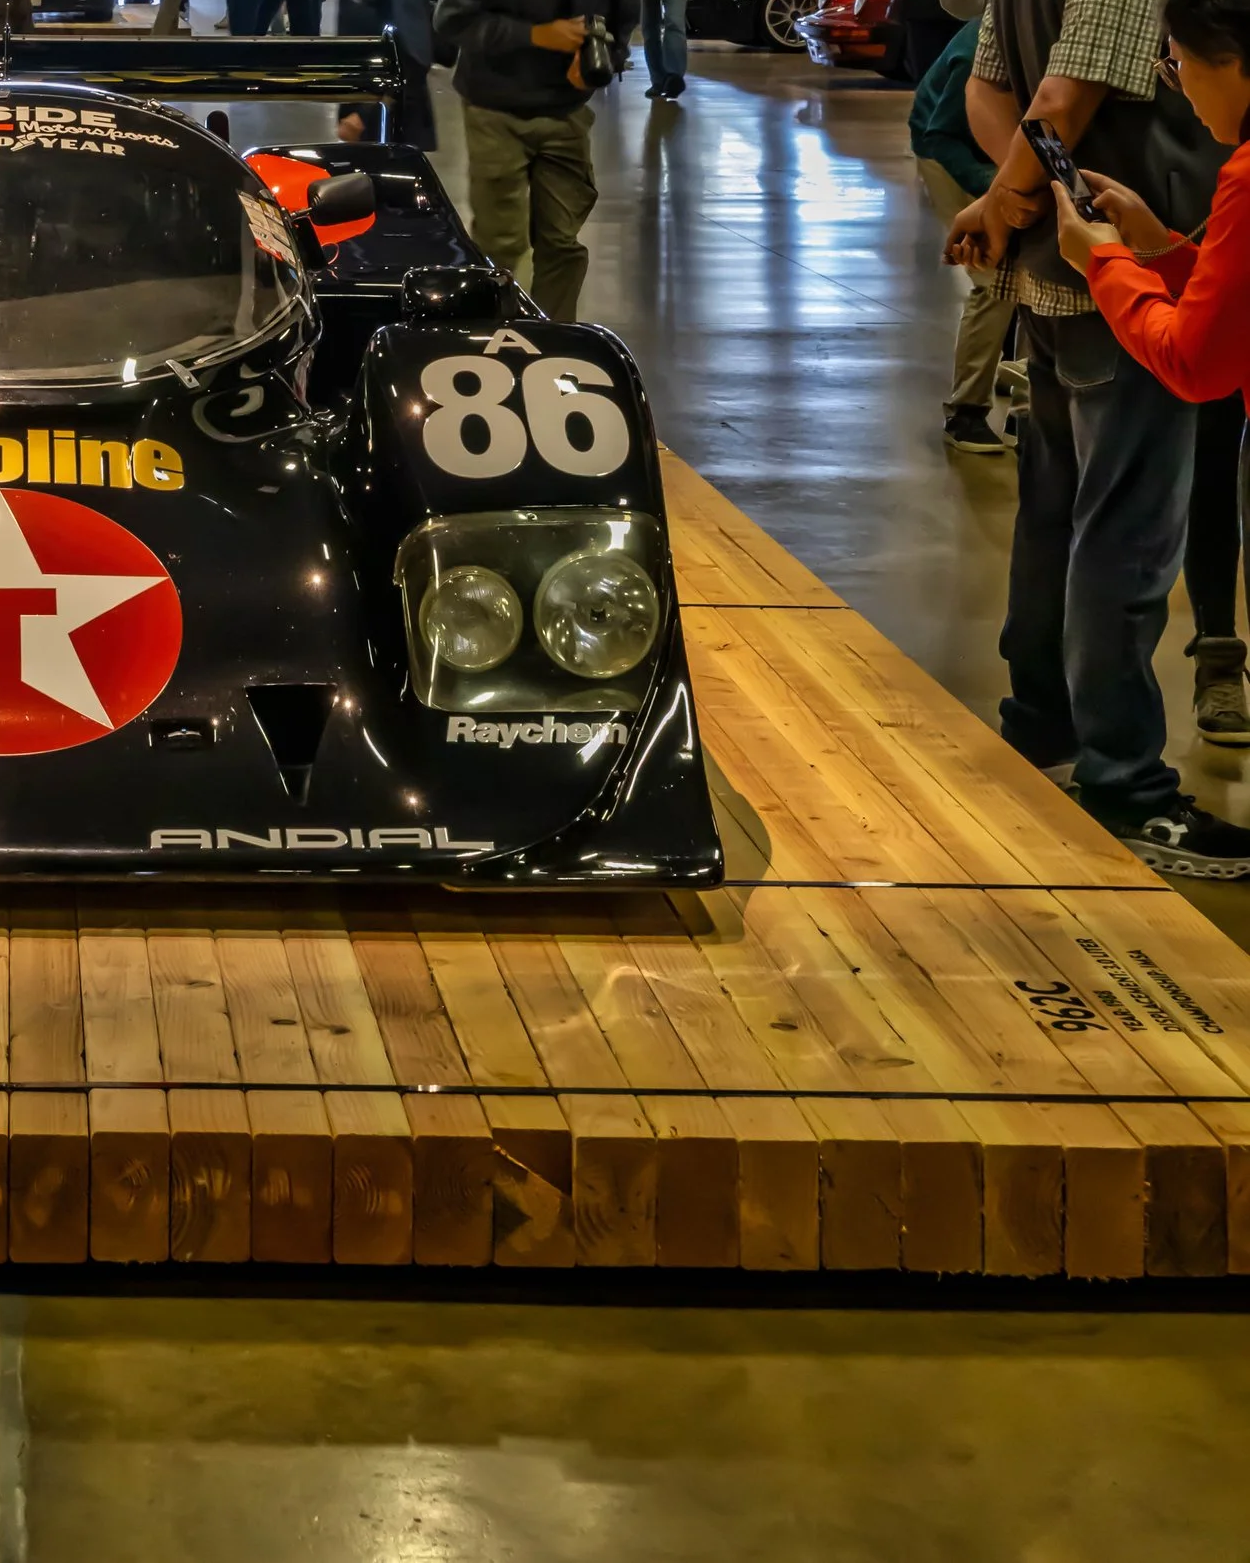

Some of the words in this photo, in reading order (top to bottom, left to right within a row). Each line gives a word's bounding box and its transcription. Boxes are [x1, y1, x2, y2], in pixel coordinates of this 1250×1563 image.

[19, 121, 179, 149] Motorsports
[483, 329, 542, 354] A
[420, 355, 629, 478] 86
[447, 716, 628, 748] Raychem
[150, 827, 494, 850] ANDIAL
[1075, 938, 1110, 959] LITER
[1126, 949, 1158, 969] IMSA
[1014, 980, 1109, 1031] 962C
